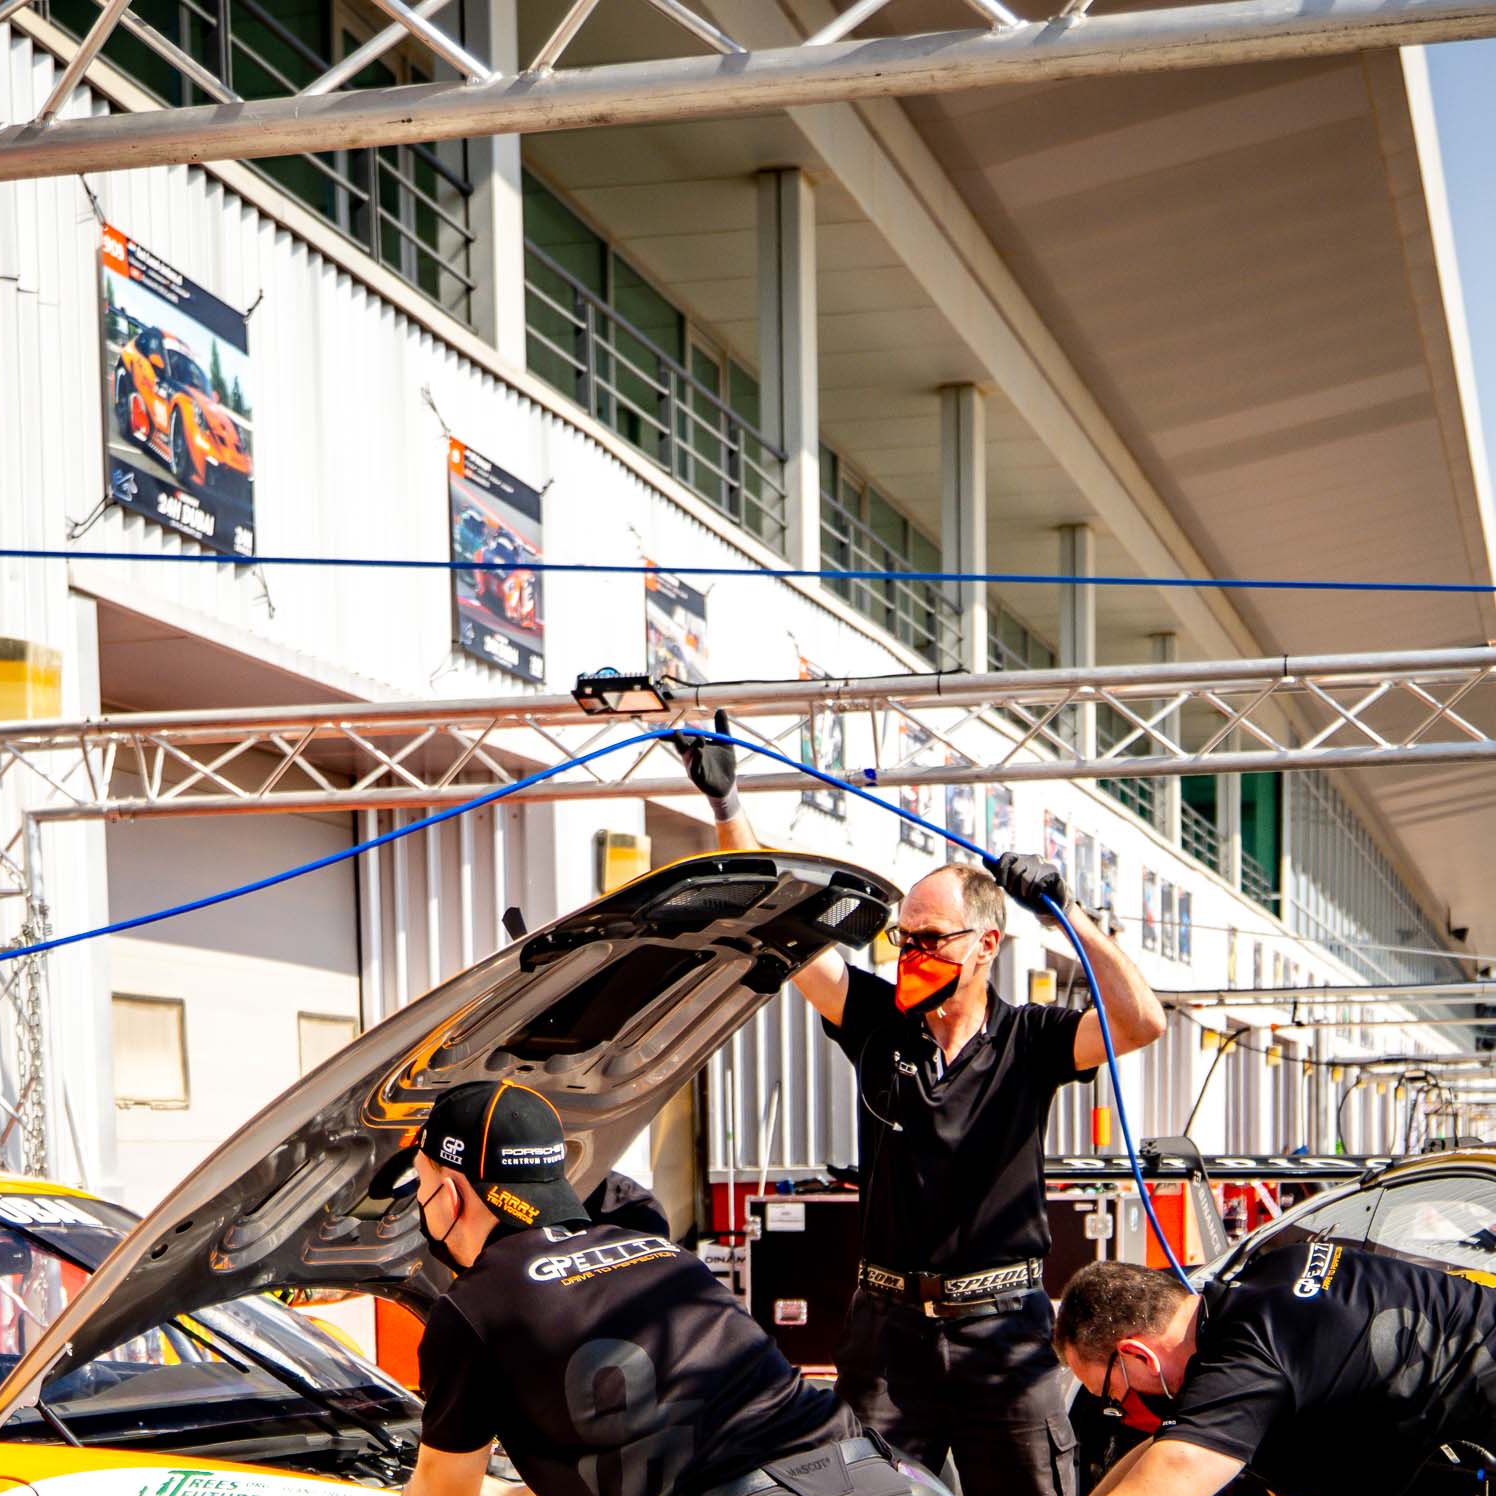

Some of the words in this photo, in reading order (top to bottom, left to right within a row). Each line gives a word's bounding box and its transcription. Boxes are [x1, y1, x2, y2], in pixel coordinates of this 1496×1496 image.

[441, 1136, 465, 1155] GP
[488, 1185, 541, 1218] LARRY
[528, 1255, 574, 1282] GP
[569, 1240, 681, 1273] ELITE
